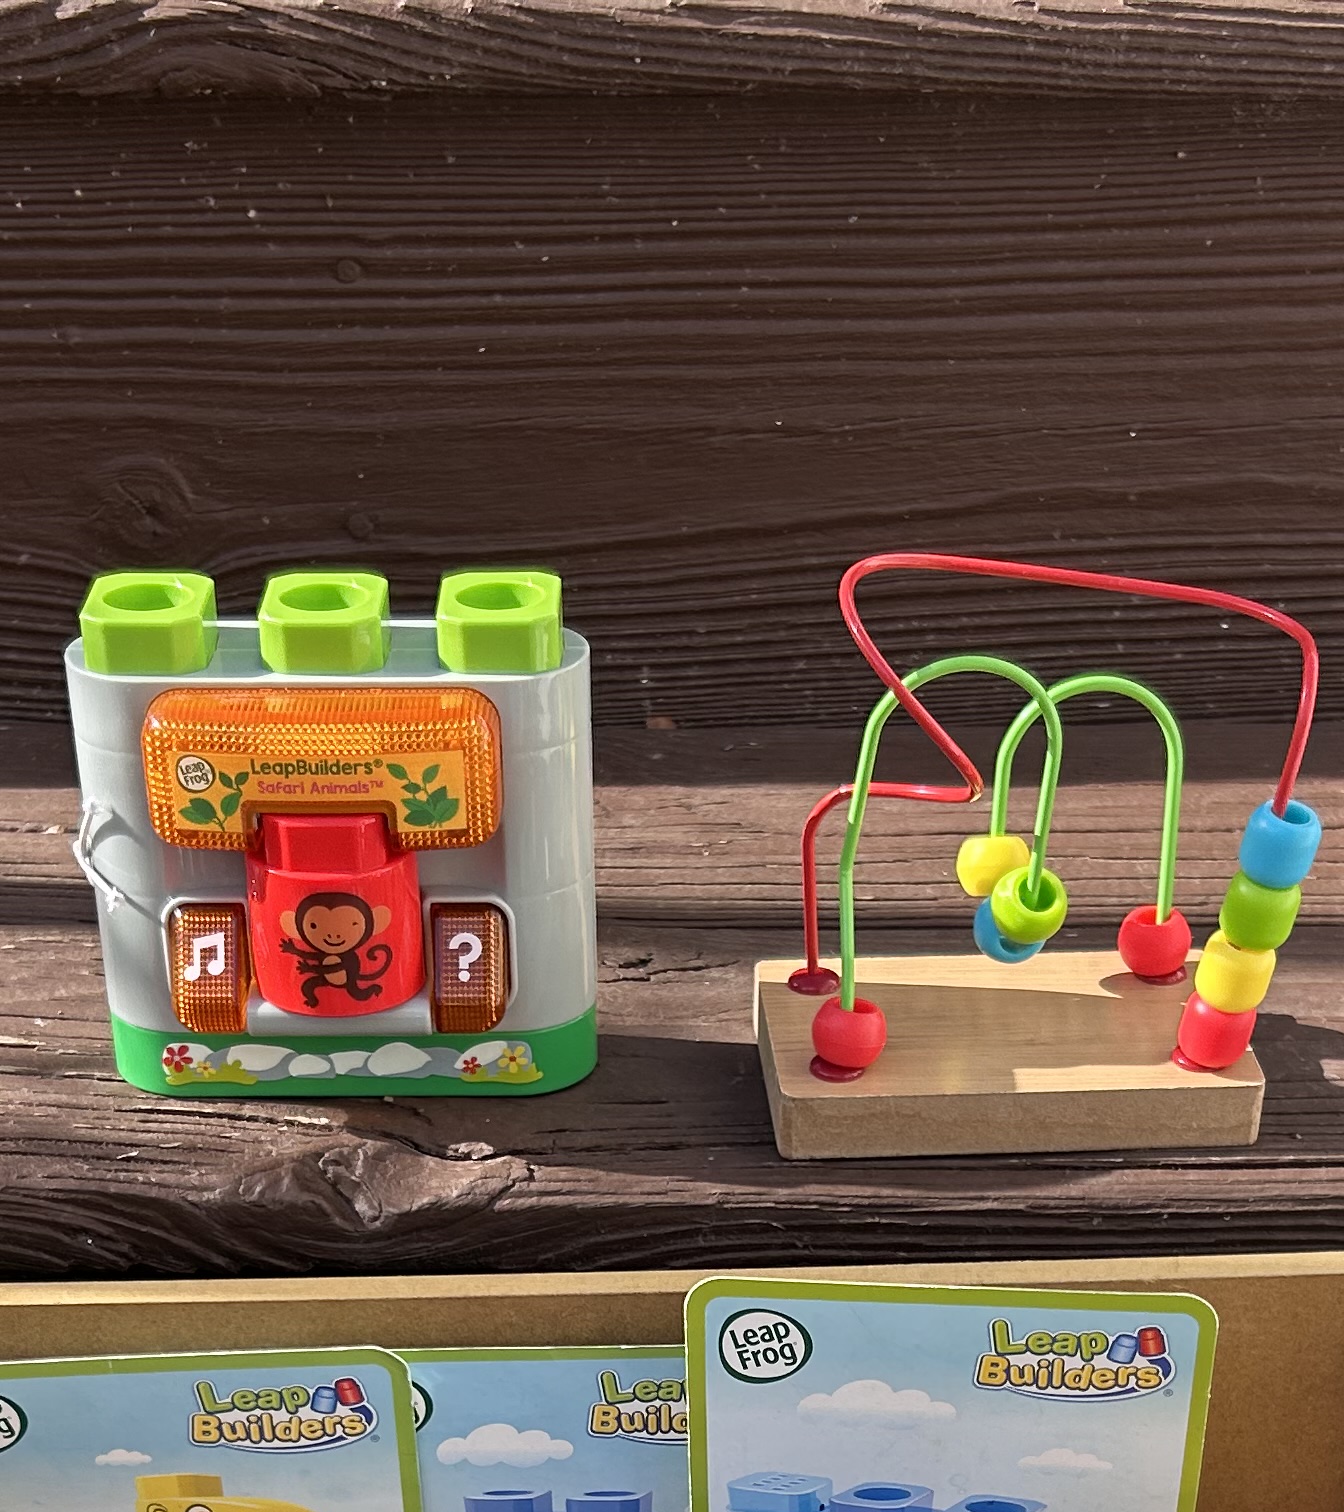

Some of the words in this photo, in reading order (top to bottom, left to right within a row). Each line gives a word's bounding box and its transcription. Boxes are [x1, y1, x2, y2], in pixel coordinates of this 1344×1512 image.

[179, 762, 205, 775] Leap
[184, 773, 209, 786] Frog
[257, 781, 305, 795] Safari
[729, 1322, 790, 1349] Leap
[991, 1319, 1109, 1362] Leap
[737, 1343, 797, 1370] Frog
[600, 1371, 687, 1404] Lea
[977, 1354, 1163, 1392] Builders
[196, 1380, 311, 1414] Leap
[191, 1412, 367, 1444] Builders
